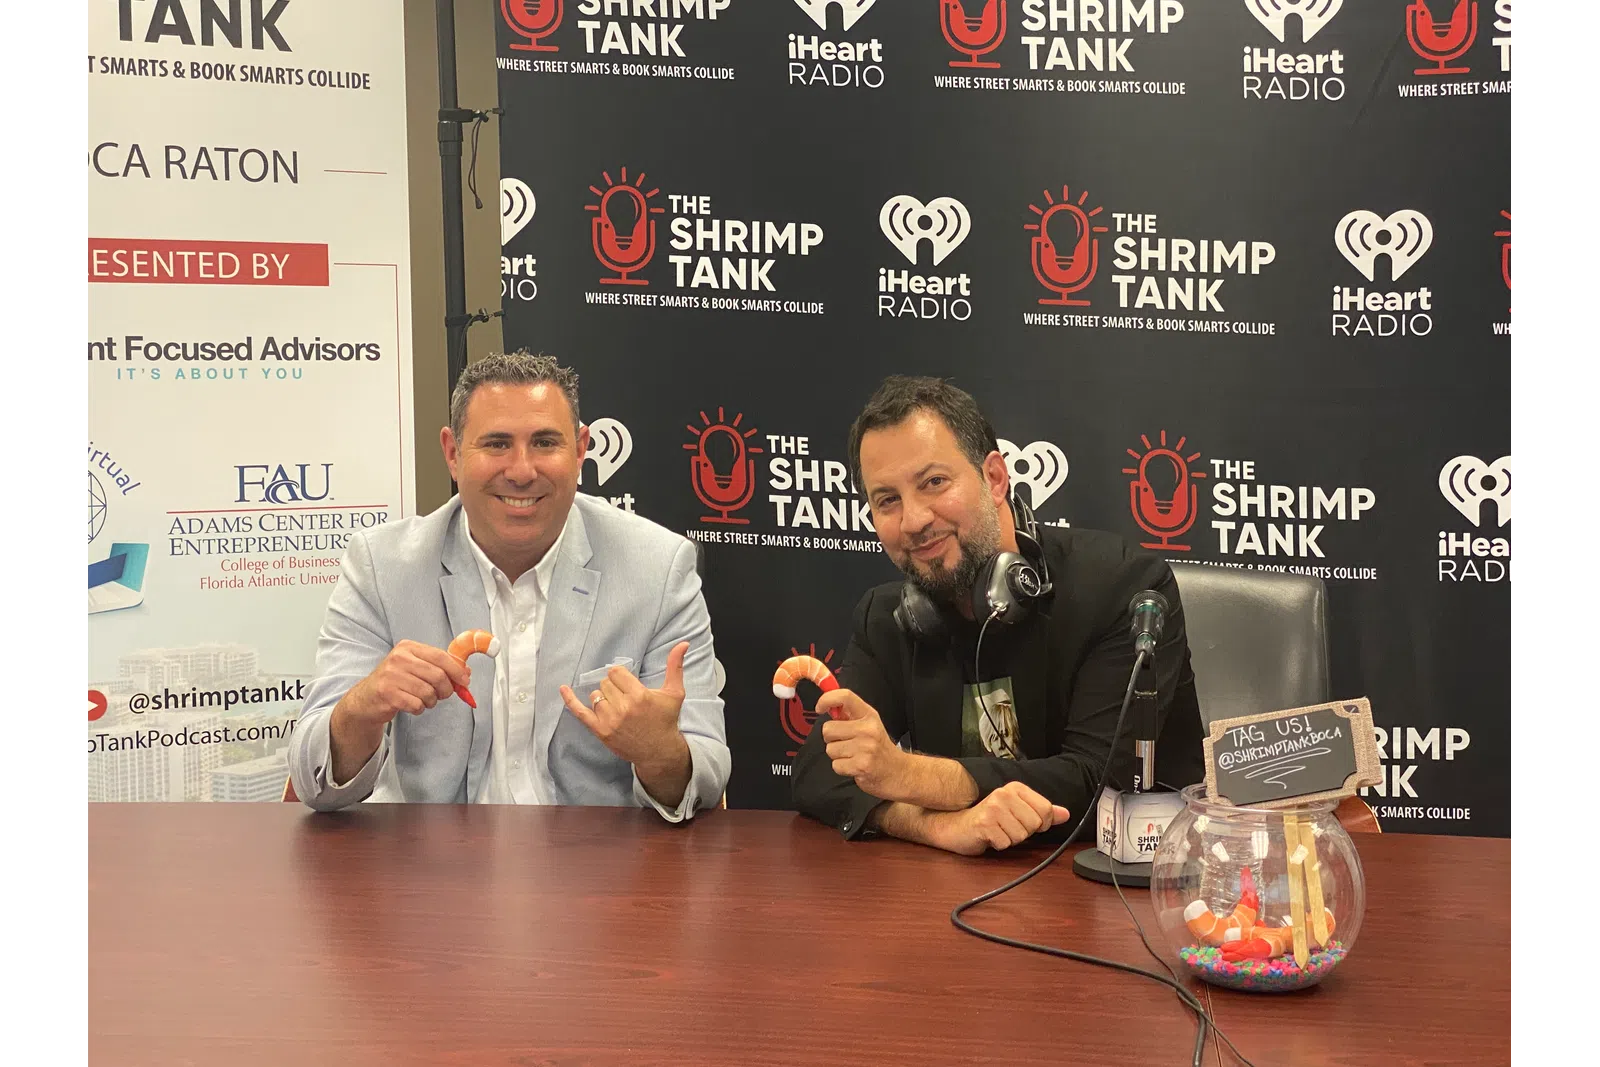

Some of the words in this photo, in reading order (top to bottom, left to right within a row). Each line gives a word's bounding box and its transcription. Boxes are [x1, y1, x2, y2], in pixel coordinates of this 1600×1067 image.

[116, 0, 293, 53] TANK
[1021, 0, 1185, 34] SHRIMP
[577, 20, 687, 57] TANK
[788, 33, 883, 63] iHeart
[496, 57, 531, 72] WHERE
[533, 59, 569, 74] STREET
[571, 61, 610, 75] SMARTS
[612, 63, 621, 76] &
[622, 63, 650, 77] BOOK
[652, 64, 692, 79] SMARTS
[694, 66, 735, 81] COLLIDE
[1021, 37, 1136, 73] TANK
[1243, 46, 1344, 75] iHeart
[100, 56, 169, 78] SMARTS
[172, 61, 186, 79] &
[190, 62, 236, 82] BOOK
[240, 65, 303, 86] SMARTS
[308, 69, 371, 91] COLLIDE
[788, 63, 885, 88] RADIO
[934, 75, 970, 91] WHERE
[972, 76, 1010, 92] STREET
[1012, 77, 1053, 92] SMARTS
[1056, 79, 1065, 93] &
[1067, 79, 1096, 94] BOOK
[1098, 80, 1140, 95] SMARTS
[1142, 81, 1186, 97] COLLIDE
[1242, 75, 1346, 101] RADIO
[1398, 84, 1438, 98] WHERE
[1440, 82, 1480, 96] STREET
[88, 142, 151, 179] CA
[164, 145, 299, 184] RATON
[668, 194, 711, 215] THE
[669, 217, 825, 256] SHRIMP
[1112, 212, 1157, 234] THE
[88, 249, 241, 279] ESENTED
[252, 253, 290, 280] BY
[501, 254, 537, 277] art
[1112, 236, 1276, 276] SHRIMP
[668, 255, 777, 292] TANK
[878, 267, 971, 296] iHeart
[585, 291, 620, 305] WHERE
[622, 293, 658, 307] STREET
[659, 294, 699, 308] SMARTS
[701, 297, 710, 308] &
[711, 297, 739, 310] BOOK
[741, 298, 782, 312] SMARTS
[783, 300, 824, 315] COLLIDE
[878, 295, 972, 321] RADIO
[1111, 274, 1225, 313] TANK
[1332, 285, 1432, 314] iHeart
[1023, 312, 1060, 327] WHERE
[1062, 314, 1099, 328] STREET
[1101, 315, 1144, 330] SMARTS
[1145, 317, 1155, 330] &
[1156, 317, 1186, 332] BOOK
[1187, 319, 1230, 333] SMARTS
[1232, 321, 1276, 335] COLLIDE
[1332, 313, 1433, 337] RADIO
[124, 335, 252, 361] Focused
[260, 336, 381, 362] Advisors
[117, 367, 161, 380] IT'S
[175, 367, 248, 380] ABOUT
[262, 367, 303, 379] YOU
[766, 434, 809, 456] THE
[88, 441, 141, 496] irtual
[769, 457, 858, 494] SHR
[1210, 458, 1255, 480] THE
[234, 463, 334, 504] FAU
[768, 494, 877, 533] TANK
[1211, 482, 1376, 521] SHRIMP
[168, 515, 253, 535] ADAMS
[259, 513, 343, 532] CENTER
[349, 511, 388, 529] FOR
[687, 529, 722, 543] WHERE
[724, 532, 758, 545] STREET
[761, 534, 800, 548] SMARTS
[803, 537, 811, 548] &
[813, 537, 841, 550] BOOK
[843, 539, 882, 553] SMARTS
[1211, 520, 1326, 558] TANK
[1439, 531, 1510, 557] iHea
[221, 558, 270, 573] College
[272, 556, 285, 569] of
[289, 555, 340, 568] Business
[1333, 567, 1377, 580] COLLIDE
[200, 575, 244, 589] Florida
[248, 573, 296, 587] Atlantic
[300, 572, 339, 585] Univer
[1225, 725, 1264, 747] TAG
[1276, 715, 1312, 736] US!
[1374, 726, 1471, 760] RIMP
[1218, 727, 1342, 769] @SHRIMPTANKBOCA
[1360, 764, 1418, 798] NK
[1381, 806, 1424, 819] SMARTS
[1427, 807, 1471, 820] COLLIDE
[1137, 835, 1161, 844] SHRI
